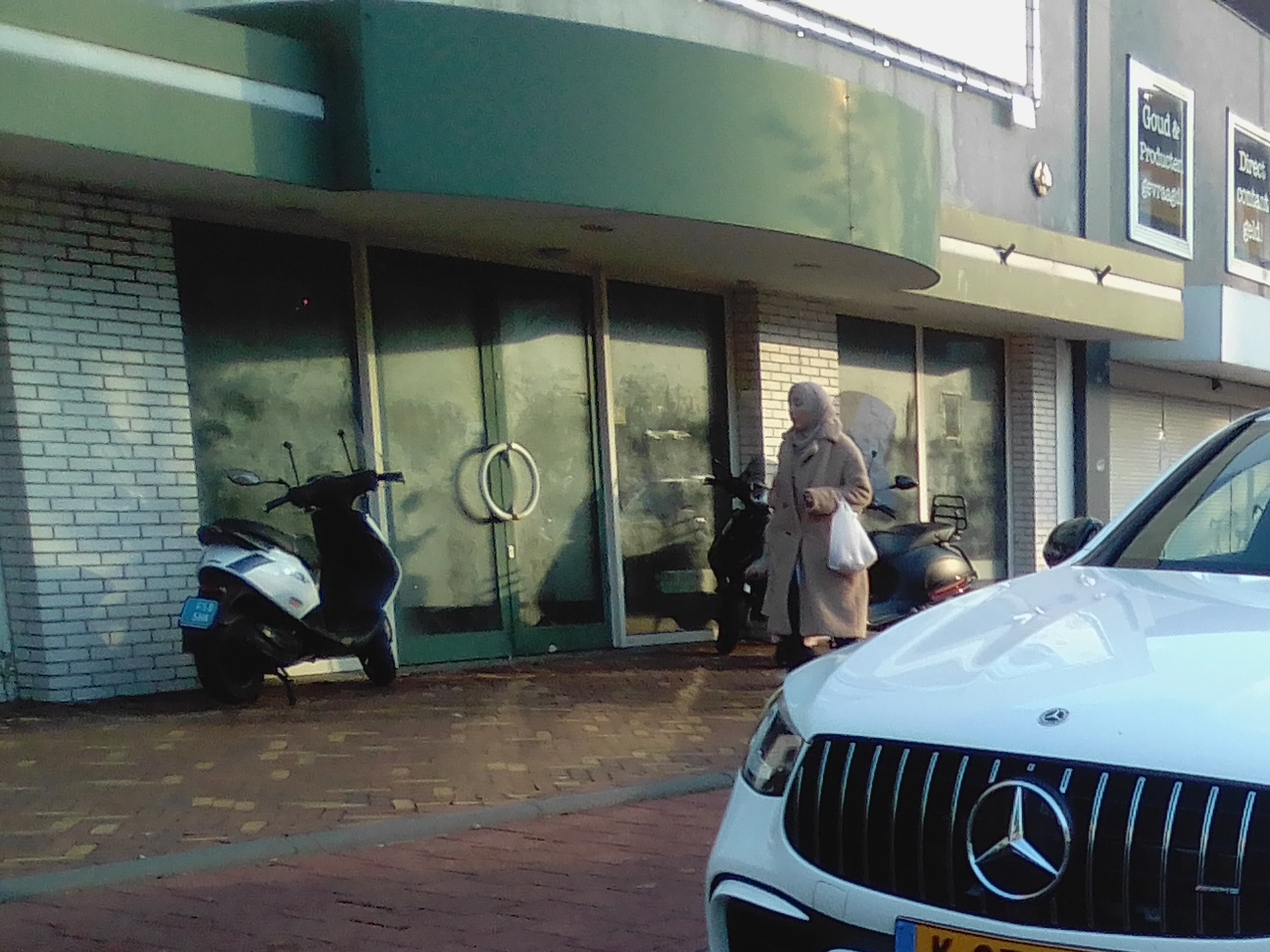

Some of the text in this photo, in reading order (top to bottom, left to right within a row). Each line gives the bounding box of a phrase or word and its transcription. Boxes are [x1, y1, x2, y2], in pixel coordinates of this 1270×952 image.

[1142, 104, 1181, 141] Goud &
[1238, 150, 1267, 181] Direct
[1236, 186, 1270, 213] contant
